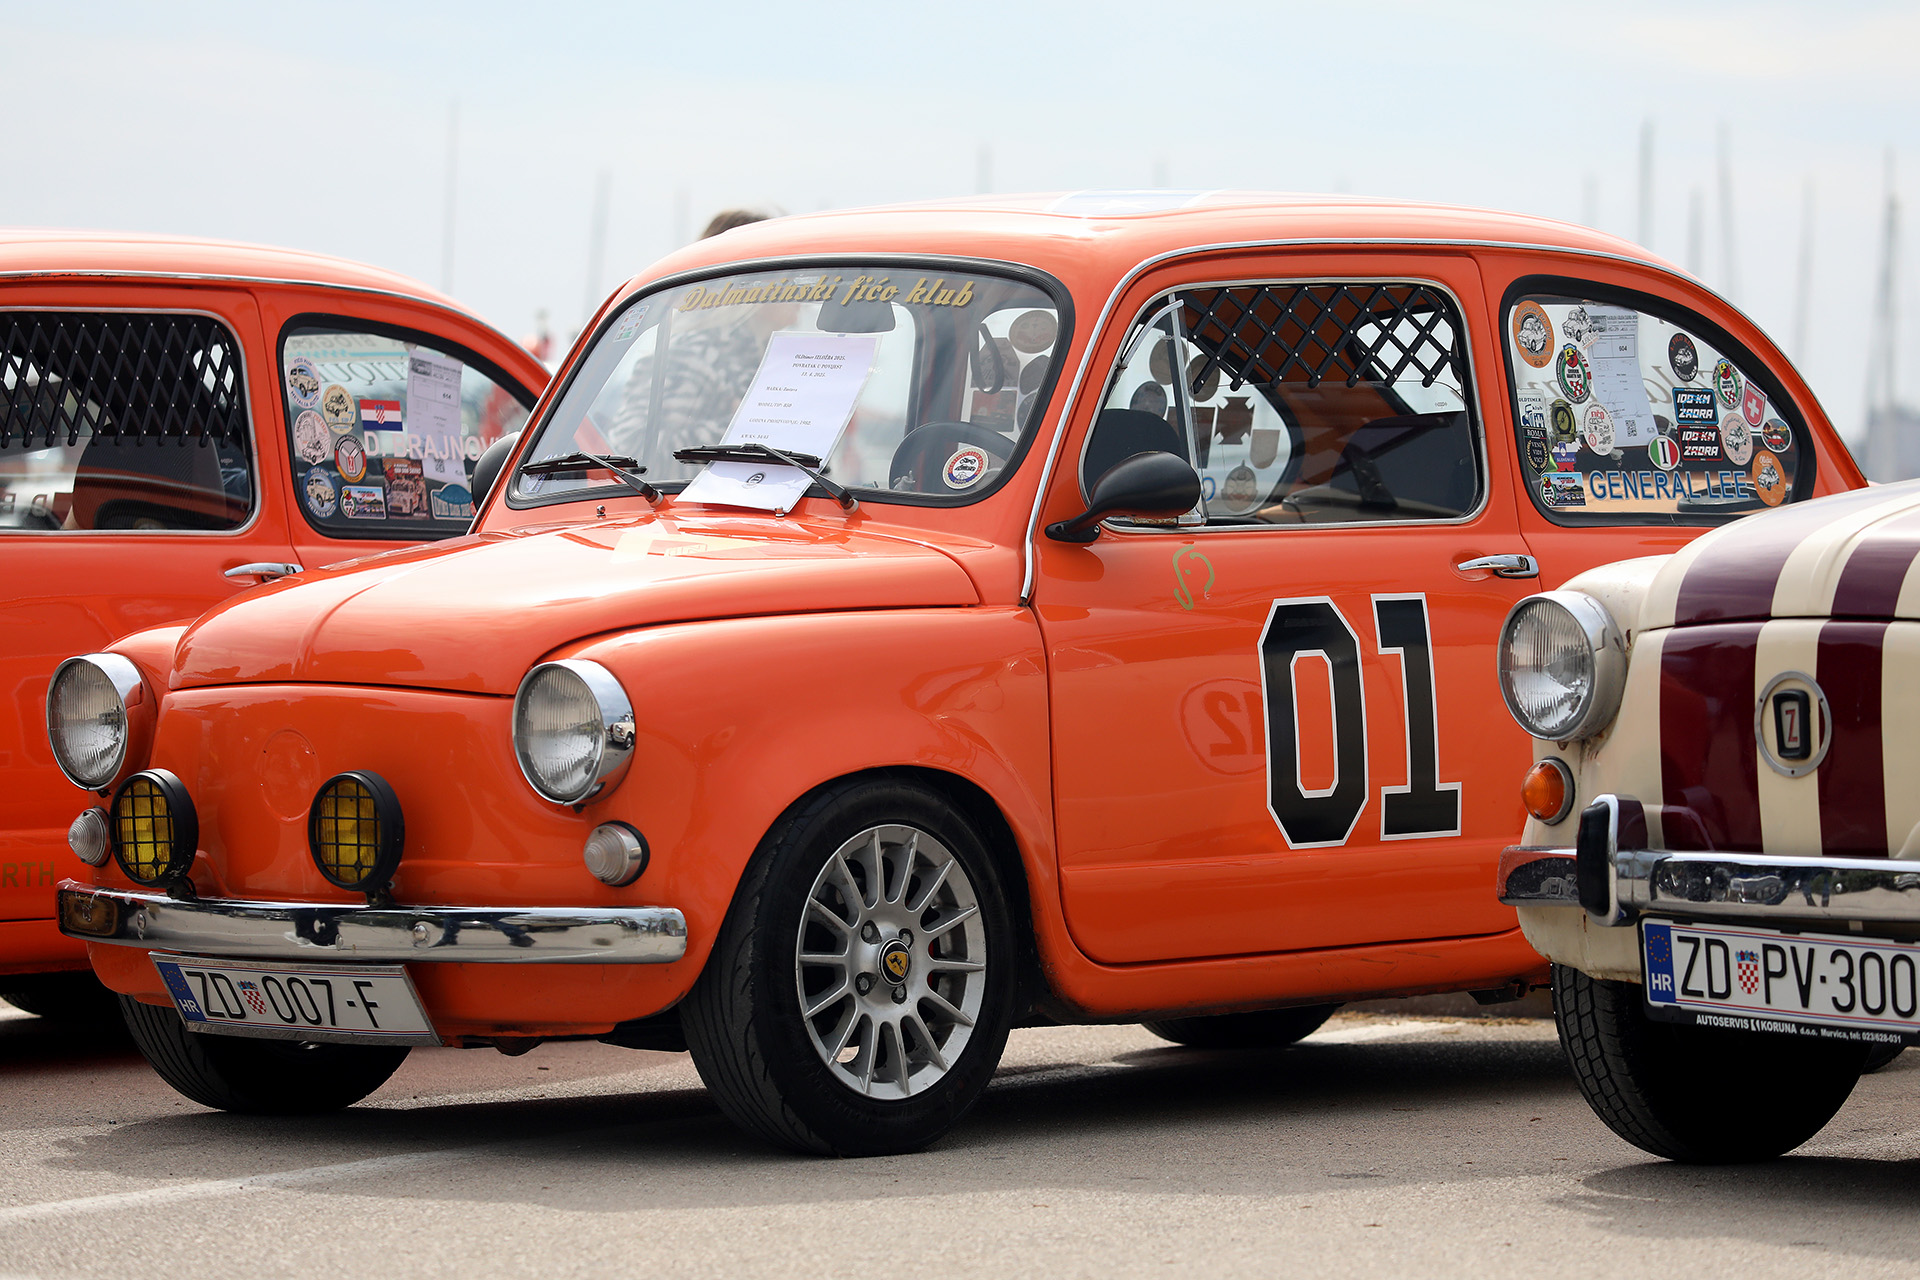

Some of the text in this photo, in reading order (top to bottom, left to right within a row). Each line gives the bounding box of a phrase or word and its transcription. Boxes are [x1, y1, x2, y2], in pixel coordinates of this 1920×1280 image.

[679, 275, 975, 312] Dalmatinski fićo klub
[1676, 393, 1694, 404] 100
[1678, 408, 1714, 419] ZADRA
[1526, 429, 1544, 438] ROMA
[1681, 430, 1699, 442] 100
[363, 431, 387, 457] D.
[391, 432, 502, 462] BRAJNOV
[1683, 445, 1719, 457] ZADRA
[1588, 470, 1750, 500] GENERAL LEE
[1257, 592, 1462, 850] 01
[1677, 935, 1732, 1000] ZD
[1651, 973, 1673, 992] HR
[180, 999, 200, 1014] HR
[185, 971, 247, 1020] ZD
[1696, 1014, 1750, 1030] AUTOSERVIS
[1760, 1020, 1798, 1034] KORUNA
[1821, 1028, 1849, 1041] Murvica,
